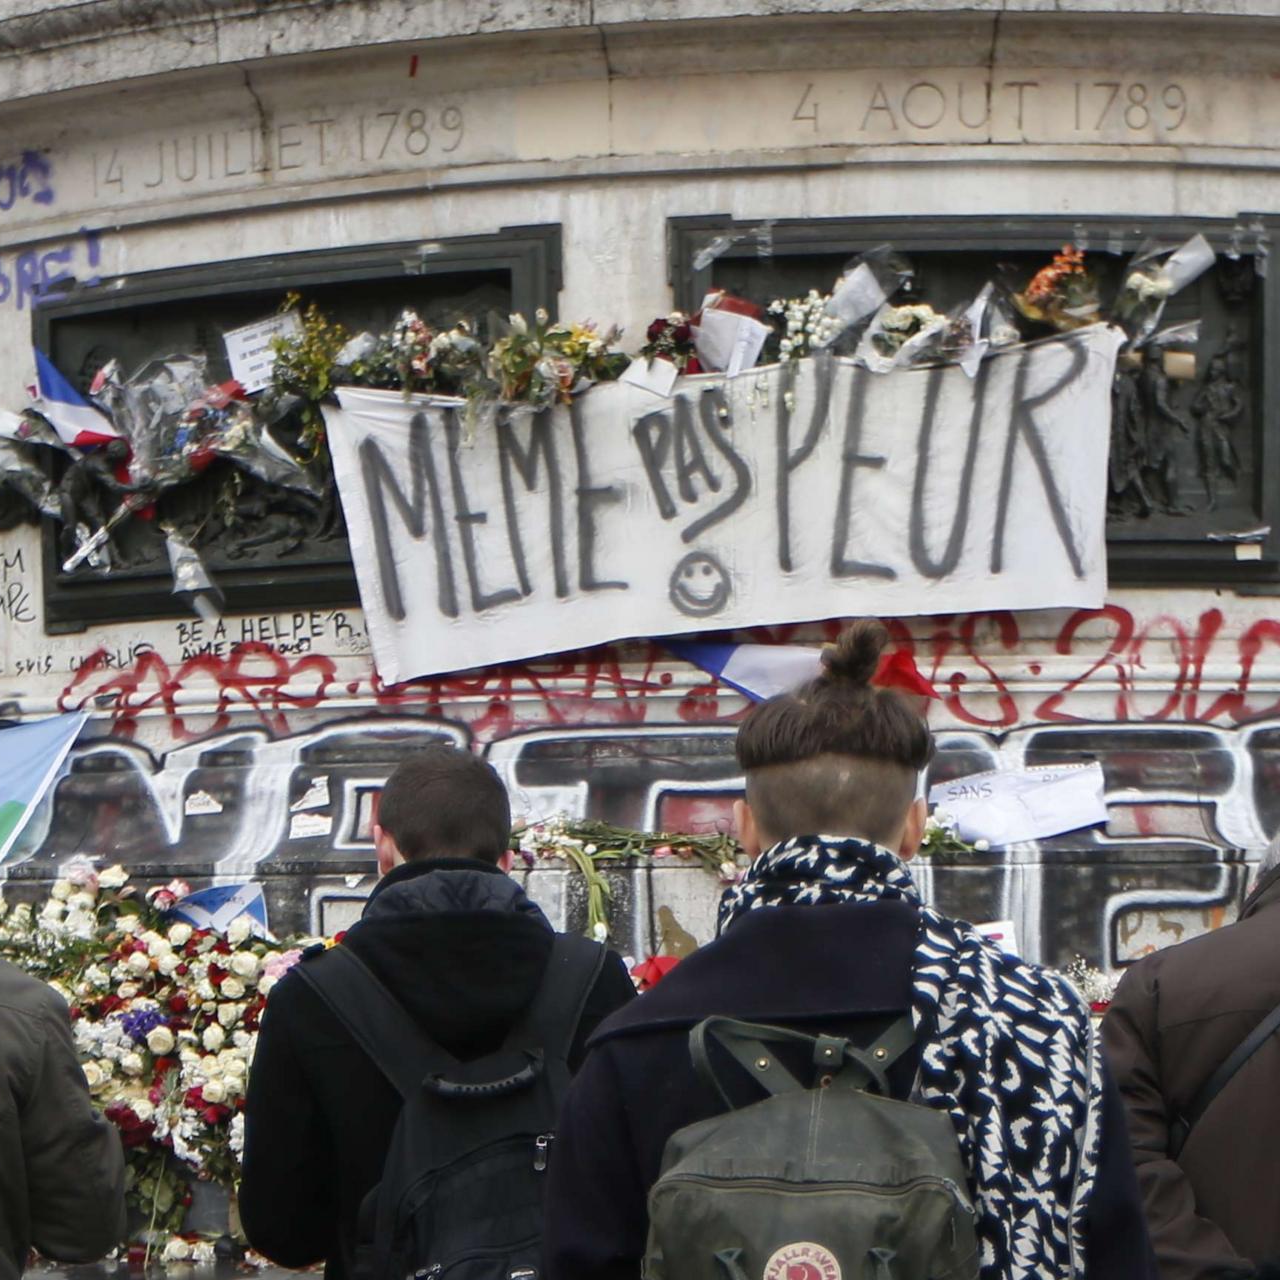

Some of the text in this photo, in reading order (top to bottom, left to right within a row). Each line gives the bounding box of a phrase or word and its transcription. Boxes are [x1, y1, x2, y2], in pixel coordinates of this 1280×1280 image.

[791, 81, 1188, 132] 4 AOUT 1789
[92, 106, 464, 198] 14 JUILLET 1789
[357, 338, 1086, 622] MEME PAS PEUR
[176, 618, 204, 645] BE
[213, 616, 228, 639] A
[946, 782, 993, 802] SANS
